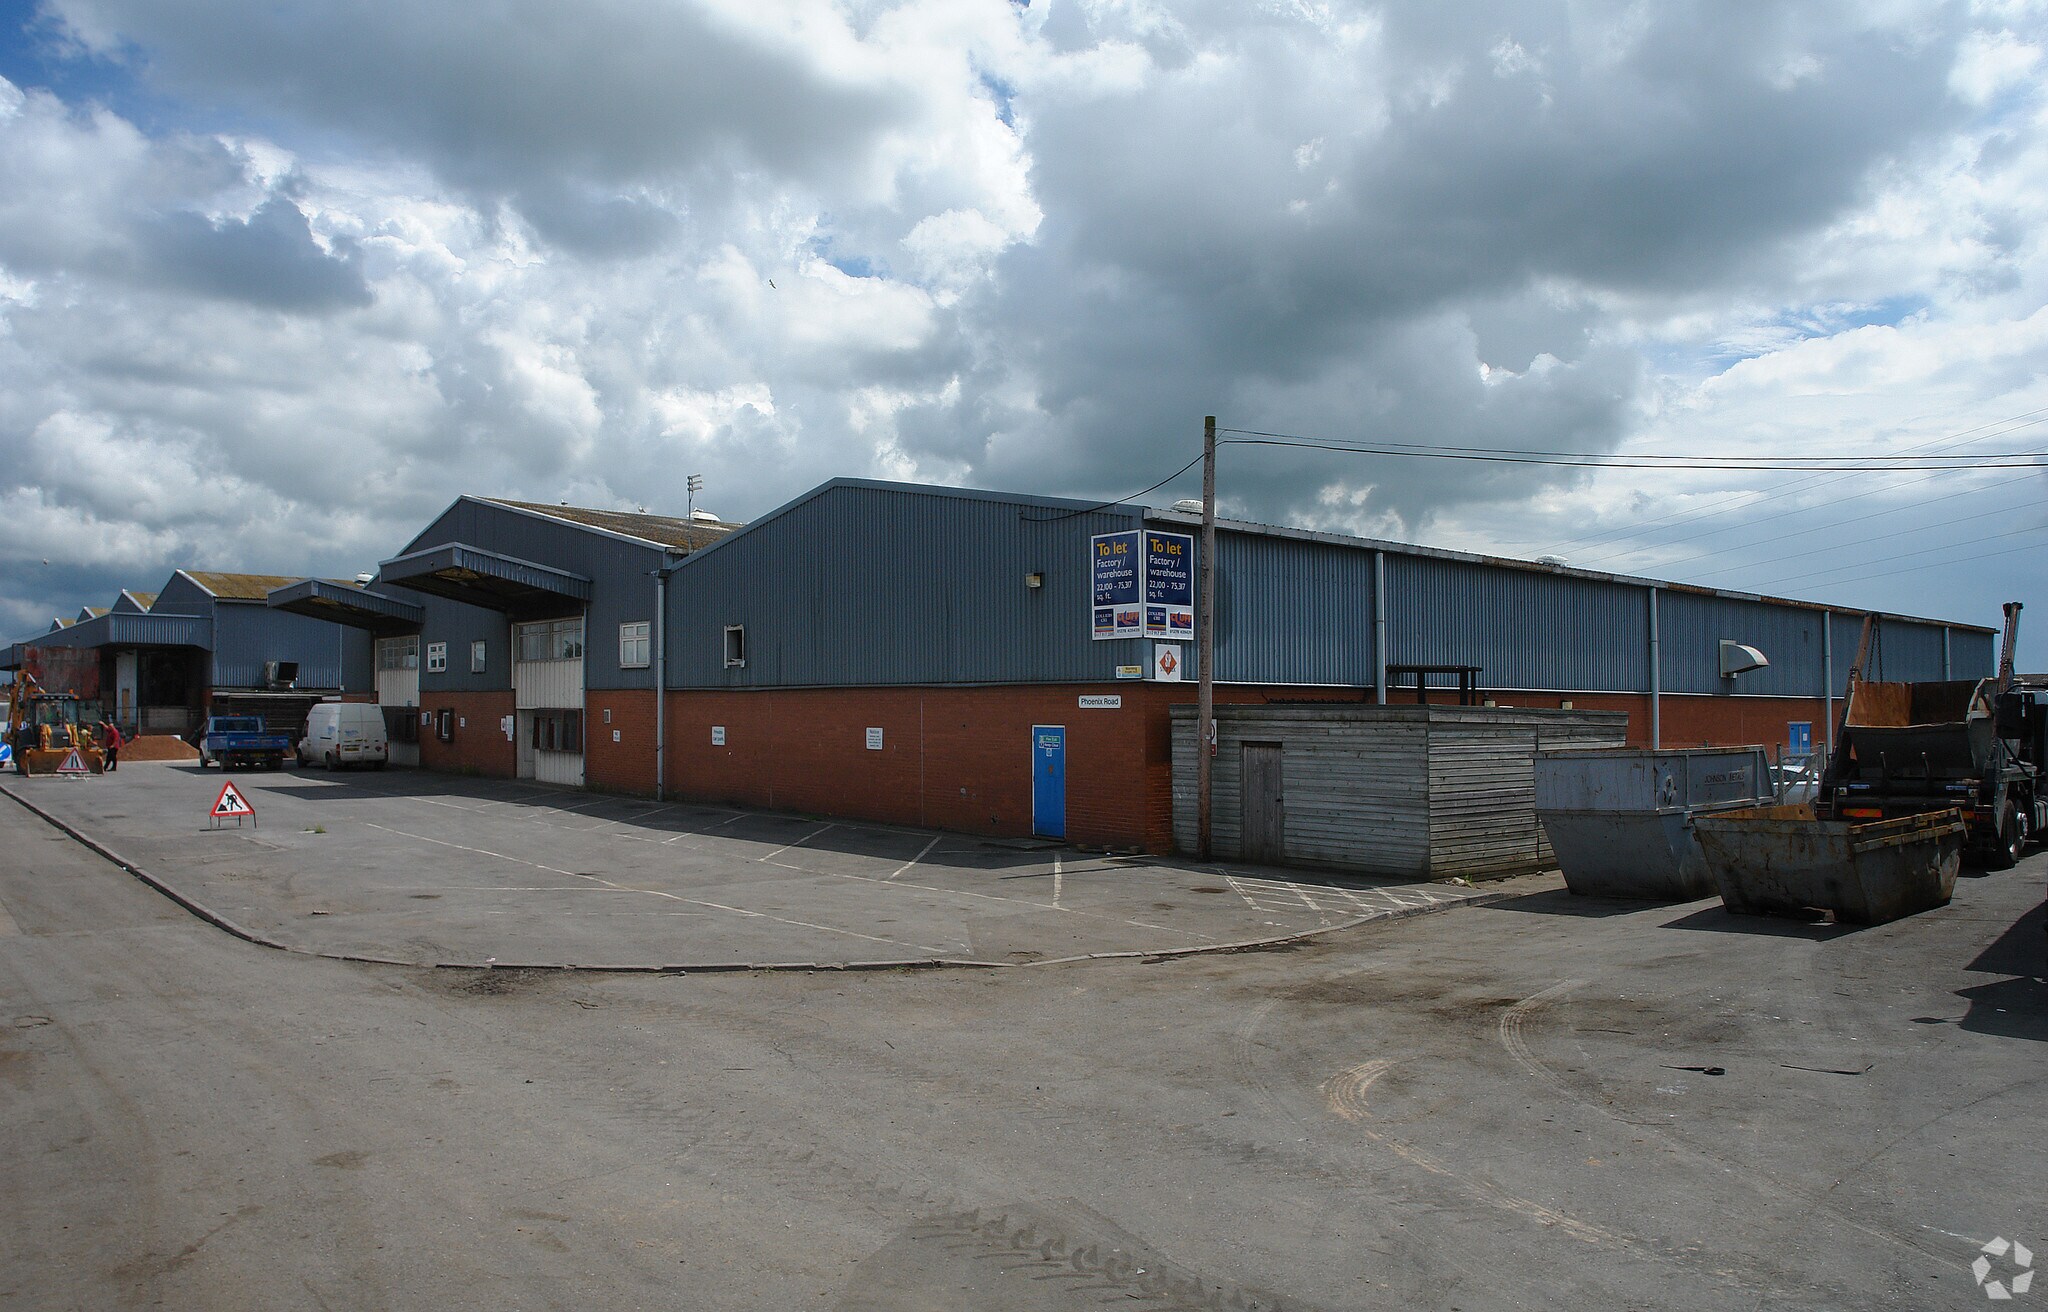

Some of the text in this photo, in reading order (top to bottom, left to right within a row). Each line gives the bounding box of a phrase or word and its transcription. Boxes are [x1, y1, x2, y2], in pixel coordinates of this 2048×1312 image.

[1097, 541, 1127, 556] To let
[1150, 538, 1181, 555] To let
[1097, 559, 1121, 568] Factory
[1150, 555, 1176, 568] Factory
[1097, 569, 1133, 579] warehouse
[1150, 569, 1186, 578] warehouse
